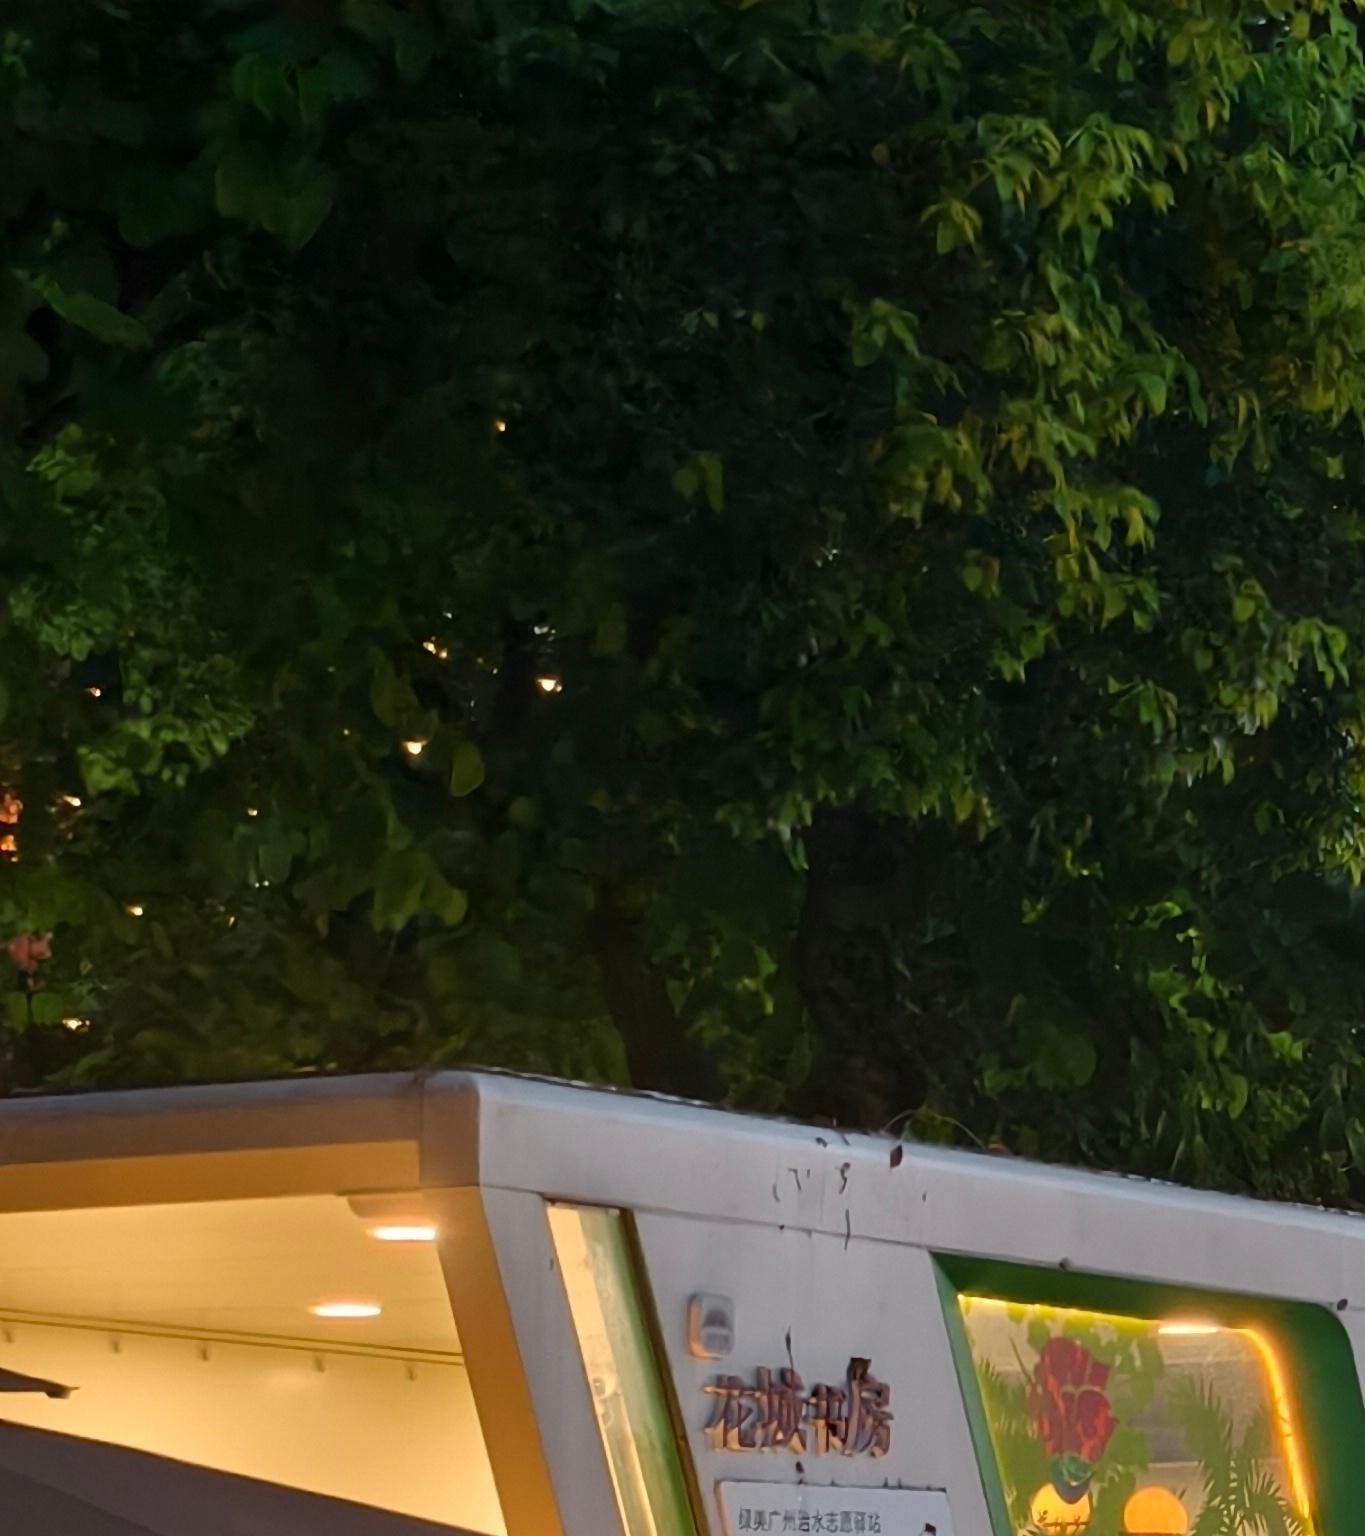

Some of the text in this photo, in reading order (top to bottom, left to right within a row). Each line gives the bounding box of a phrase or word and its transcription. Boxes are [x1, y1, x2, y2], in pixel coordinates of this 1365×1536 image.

[738, 1508, 882, 1534] 绿美广州治水志愿驿站
